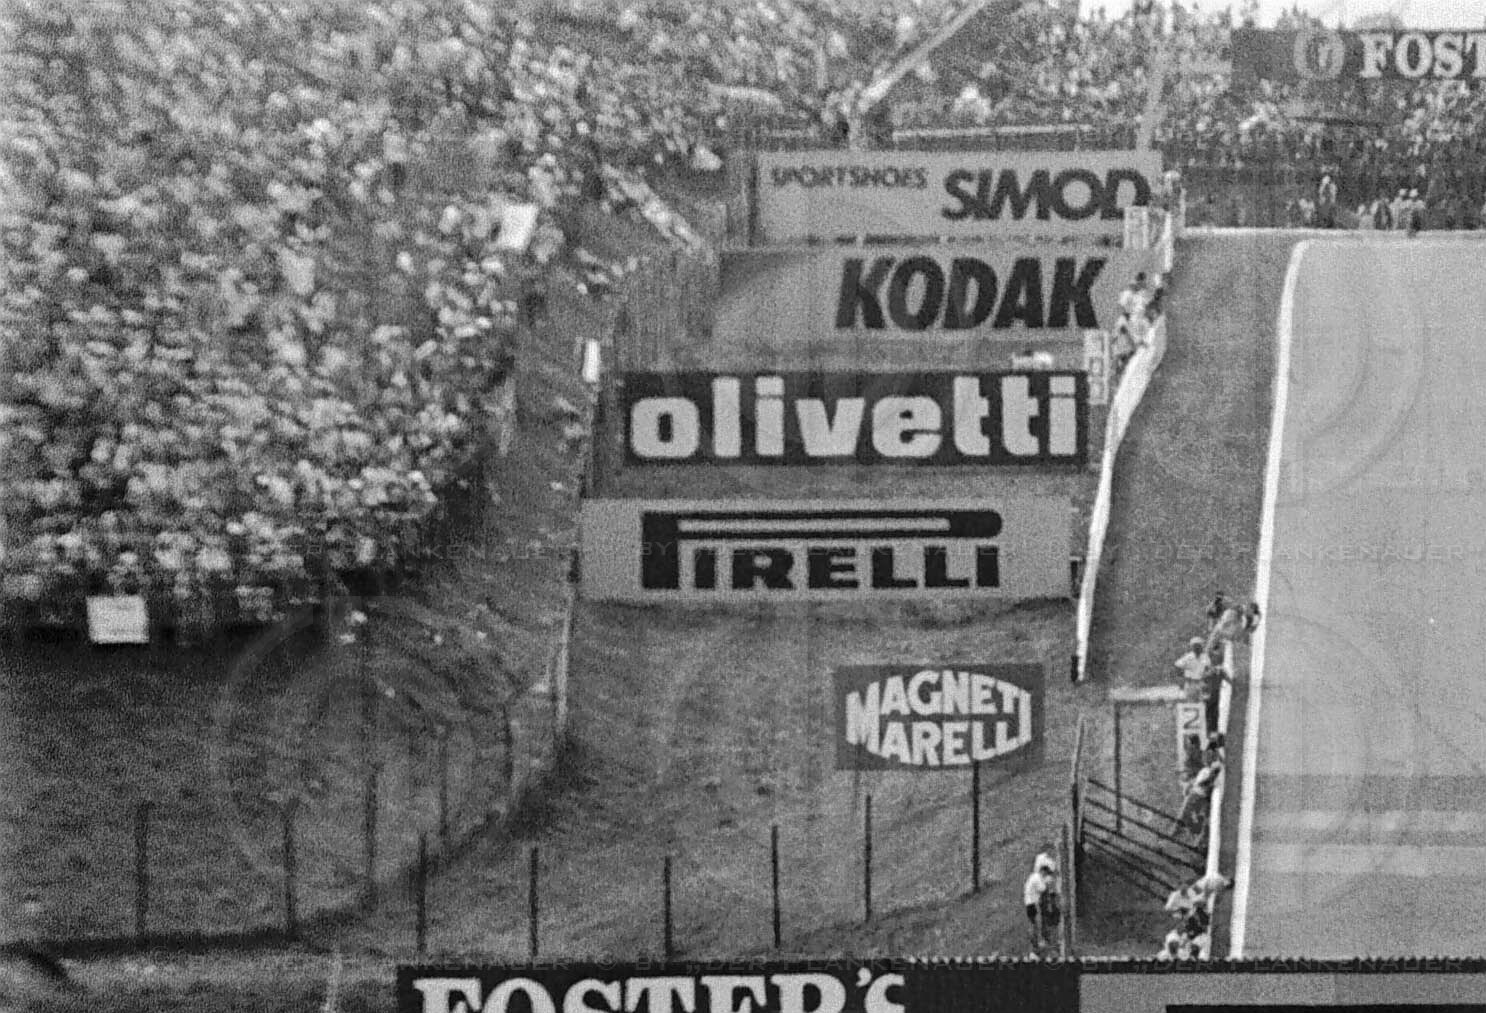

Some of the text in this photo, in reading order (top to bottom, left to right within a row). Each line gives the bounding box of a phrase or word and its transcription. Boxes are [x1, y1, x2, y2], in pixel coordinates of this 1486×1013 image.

[941, 168, 1152, 222] SIMOD
[835, 255, 1107, 331] KODAK
[628, 375, 1078, 460] olivetti
[641, 509, 1003, 590] PIRELLI
[845, 670, 1032, 756] MAGNETI
[845, 688, 1032, 767] MARELLI
